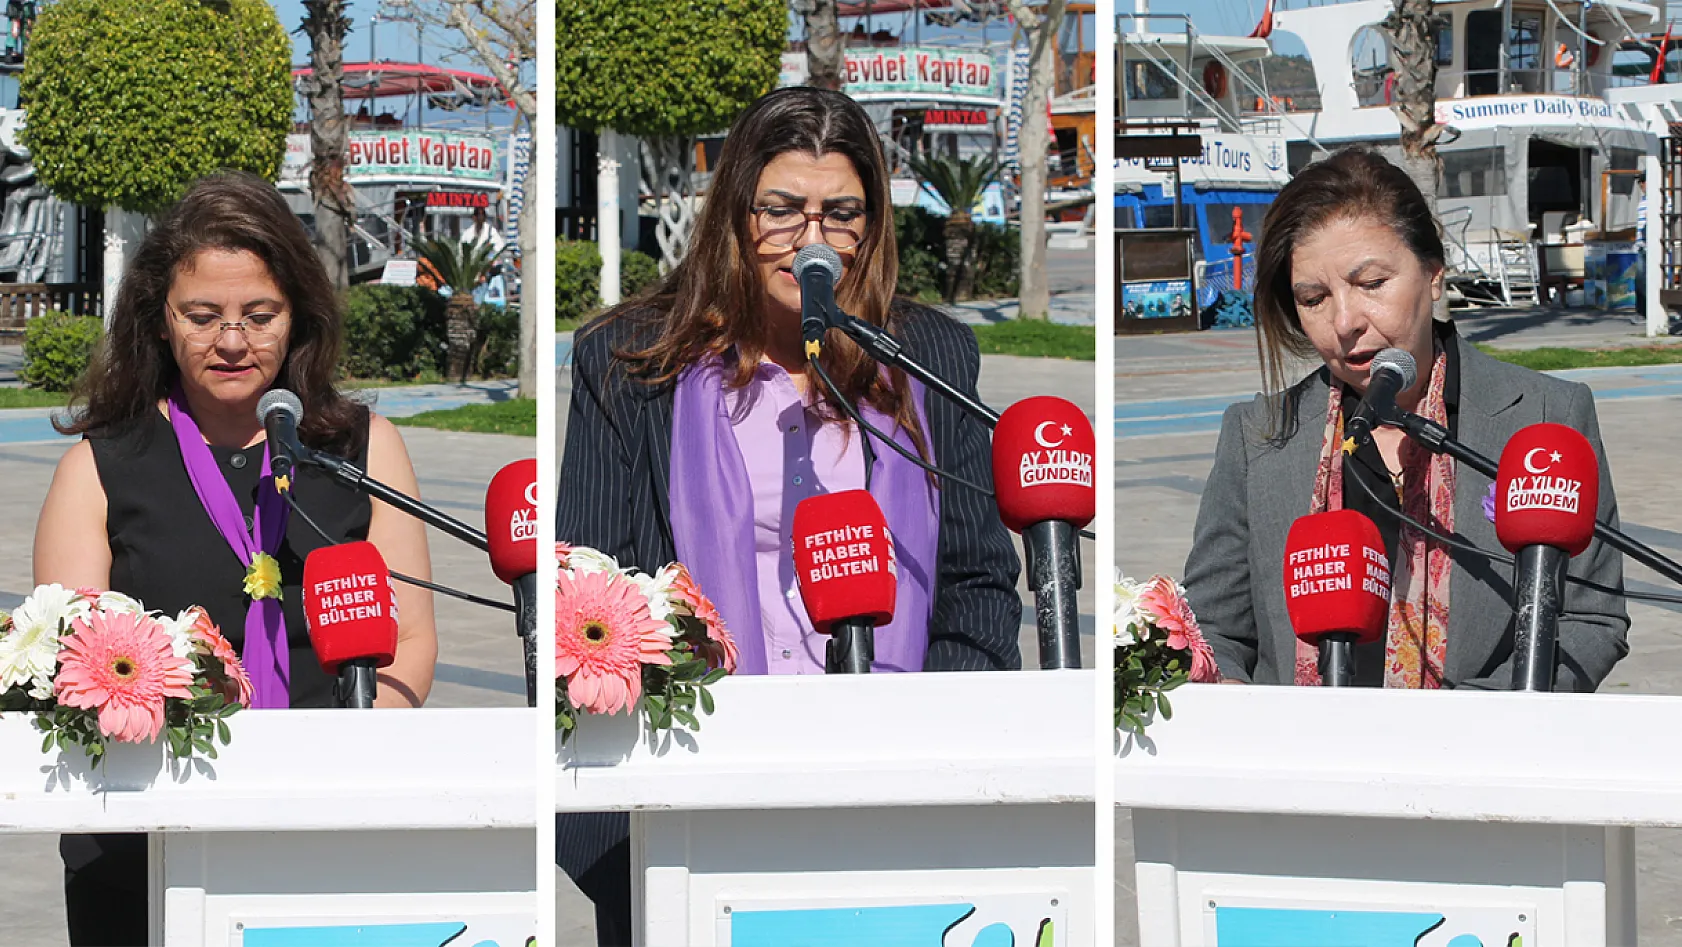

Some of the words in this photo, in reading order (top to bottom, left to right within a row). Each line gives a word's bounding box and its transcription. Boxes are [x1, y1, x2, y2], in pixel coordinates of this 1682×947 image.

[916, 54, 991, 88] Kaptan
[923, 109, 988, 125] AMINTAS
[1453, 103, 1528, 120] Summer
[1534, 98, 1575, 119] Daily
[1579, 101, 1613, 118] Boat
[418, 137, 493, 172] Kaptan
[1214, 141, 1251, 172] Tours
[426, 191, 489, 208] AMINTAS
[1020, 450, 1042, 467] AY
[1045, 449, 1092, 468] YILDIZ
[1023, 465, 1092, 484] GÜNDEM
[1508, 476, 1528, 493] AY
[1531, 475, 1582, 494] YILDIZ
[1509, 490, 1577, 511] GÜNDEM
[511, 507, 531, 524] AY
[805, 524, 874, 549] FETHİYE
[812, 542, 871, 564] HABER
[1289, 543, 1350, 566] FETHİYE
[810, 555, 879, 584] BÜLTENİ
[1293, 561, 1346, 581] HABER
[314, 573, 378, 596] FETHİYE
[1290, 573, 1352, 599] BÜLTENİ
[321, 589, 375, 610] HABER
[318, 601, 382, 627] BÜLTENİ
